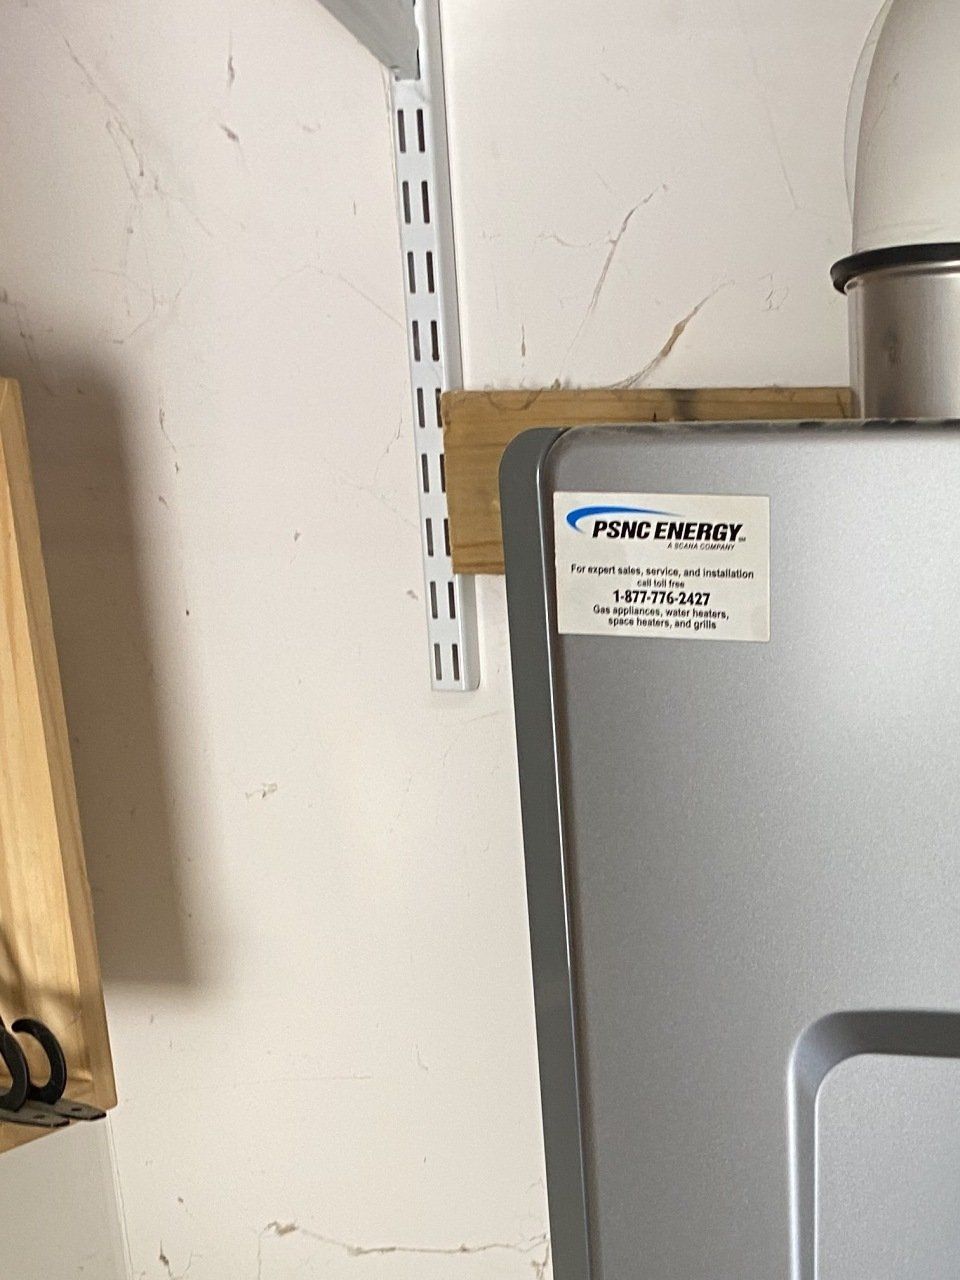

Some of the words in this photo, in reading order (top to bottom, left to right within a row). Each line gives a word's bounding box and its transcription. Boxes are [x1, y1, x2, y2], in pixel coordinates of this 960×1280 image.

[592, 520, 651, 539] PSNC
[654, 521, 743, 541] ENERGY
[667, 542, 674, 550] A
[674, 542, 698, 550] SCANA
[700, 543, 736, 551] COMPANY
[571, 564, 586, 573] For
[588, 566, 615, 577] expert
[618, 566, 643, 577] sales,
[646, 567, 681, 578] service,
[683, 568, 701, 577] and
[702, 568, 754, 579] installation
[637, 579, 651, 588] call
[653, 579, 667, 588] toll
[668, 580, 685, 588] free
[612, 589, 711, 606] 1-877-776-2427
[593, 605, 610, 615] Gas
[612, 606, 663, 618] appliances,
[665, 608, 690, 618] water
[692, 608, 729, 620] heaters,
[608, 617, 634, 627] space
[636, 618, 673, 629] heaters,
[674, 619, 692, 628] and
[693, 620, 717, 631] grills
